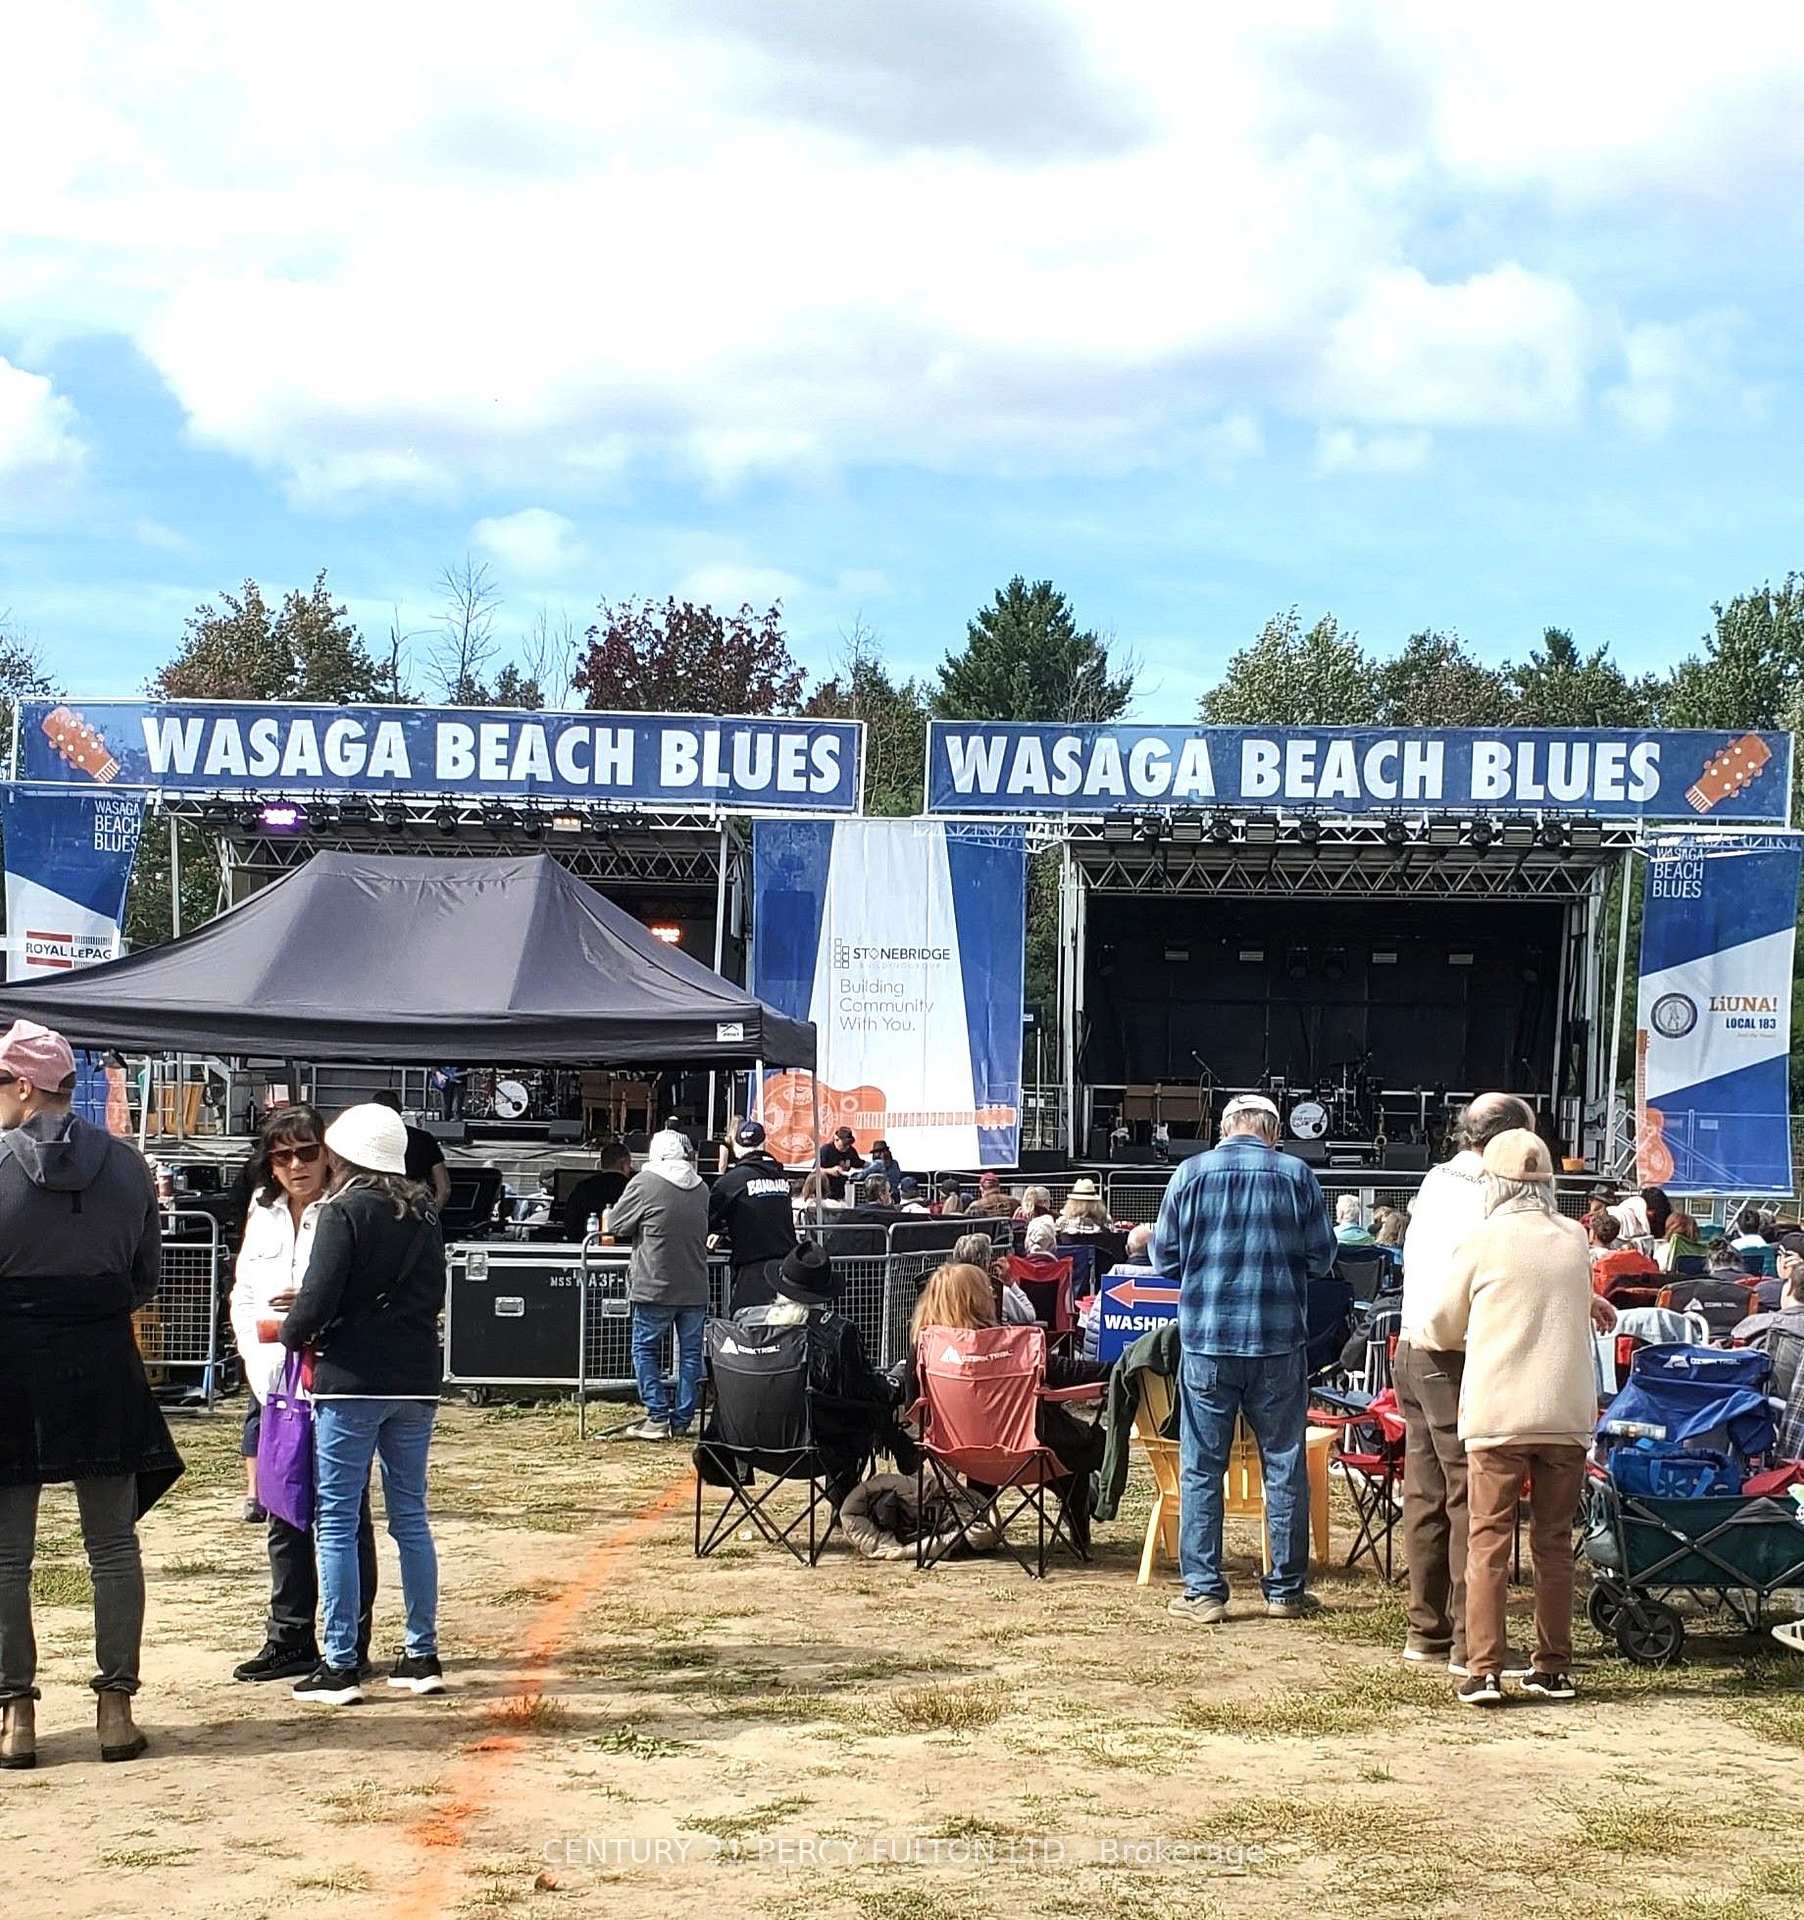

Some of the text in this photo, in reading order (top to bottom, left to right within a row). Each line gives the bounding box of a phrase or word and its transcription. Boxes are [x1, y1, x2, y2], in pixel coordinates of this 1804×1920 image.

[141, 717, 841, 794] WASAGA BEACH BLUES
[945, 736, 1660, 803] WASAGA BEACH BLUES
[95, 801, 140, 816] WASAGA
[94, 815, 140, 834] BEACH
[94, 833, 138, 852] BLUES
[1656, 847, 1704, 861] WASAGA
[1653, 861, 1704, 880] BEACH
[1652, 880, 1702, 898] BLUES
[26, 942, 68, 957] ROYAL
[853, 947, 951, 960] STONEBRIDGE
[840, 978, 904, 997] Building
[840, 997, 934, 1013] Community
[1708, 996, 1777, 1012] LiUNA!
[840, 1016, 916, 1032] With You.
[1726, 1017, 1776, 1029] LOCAL 183
